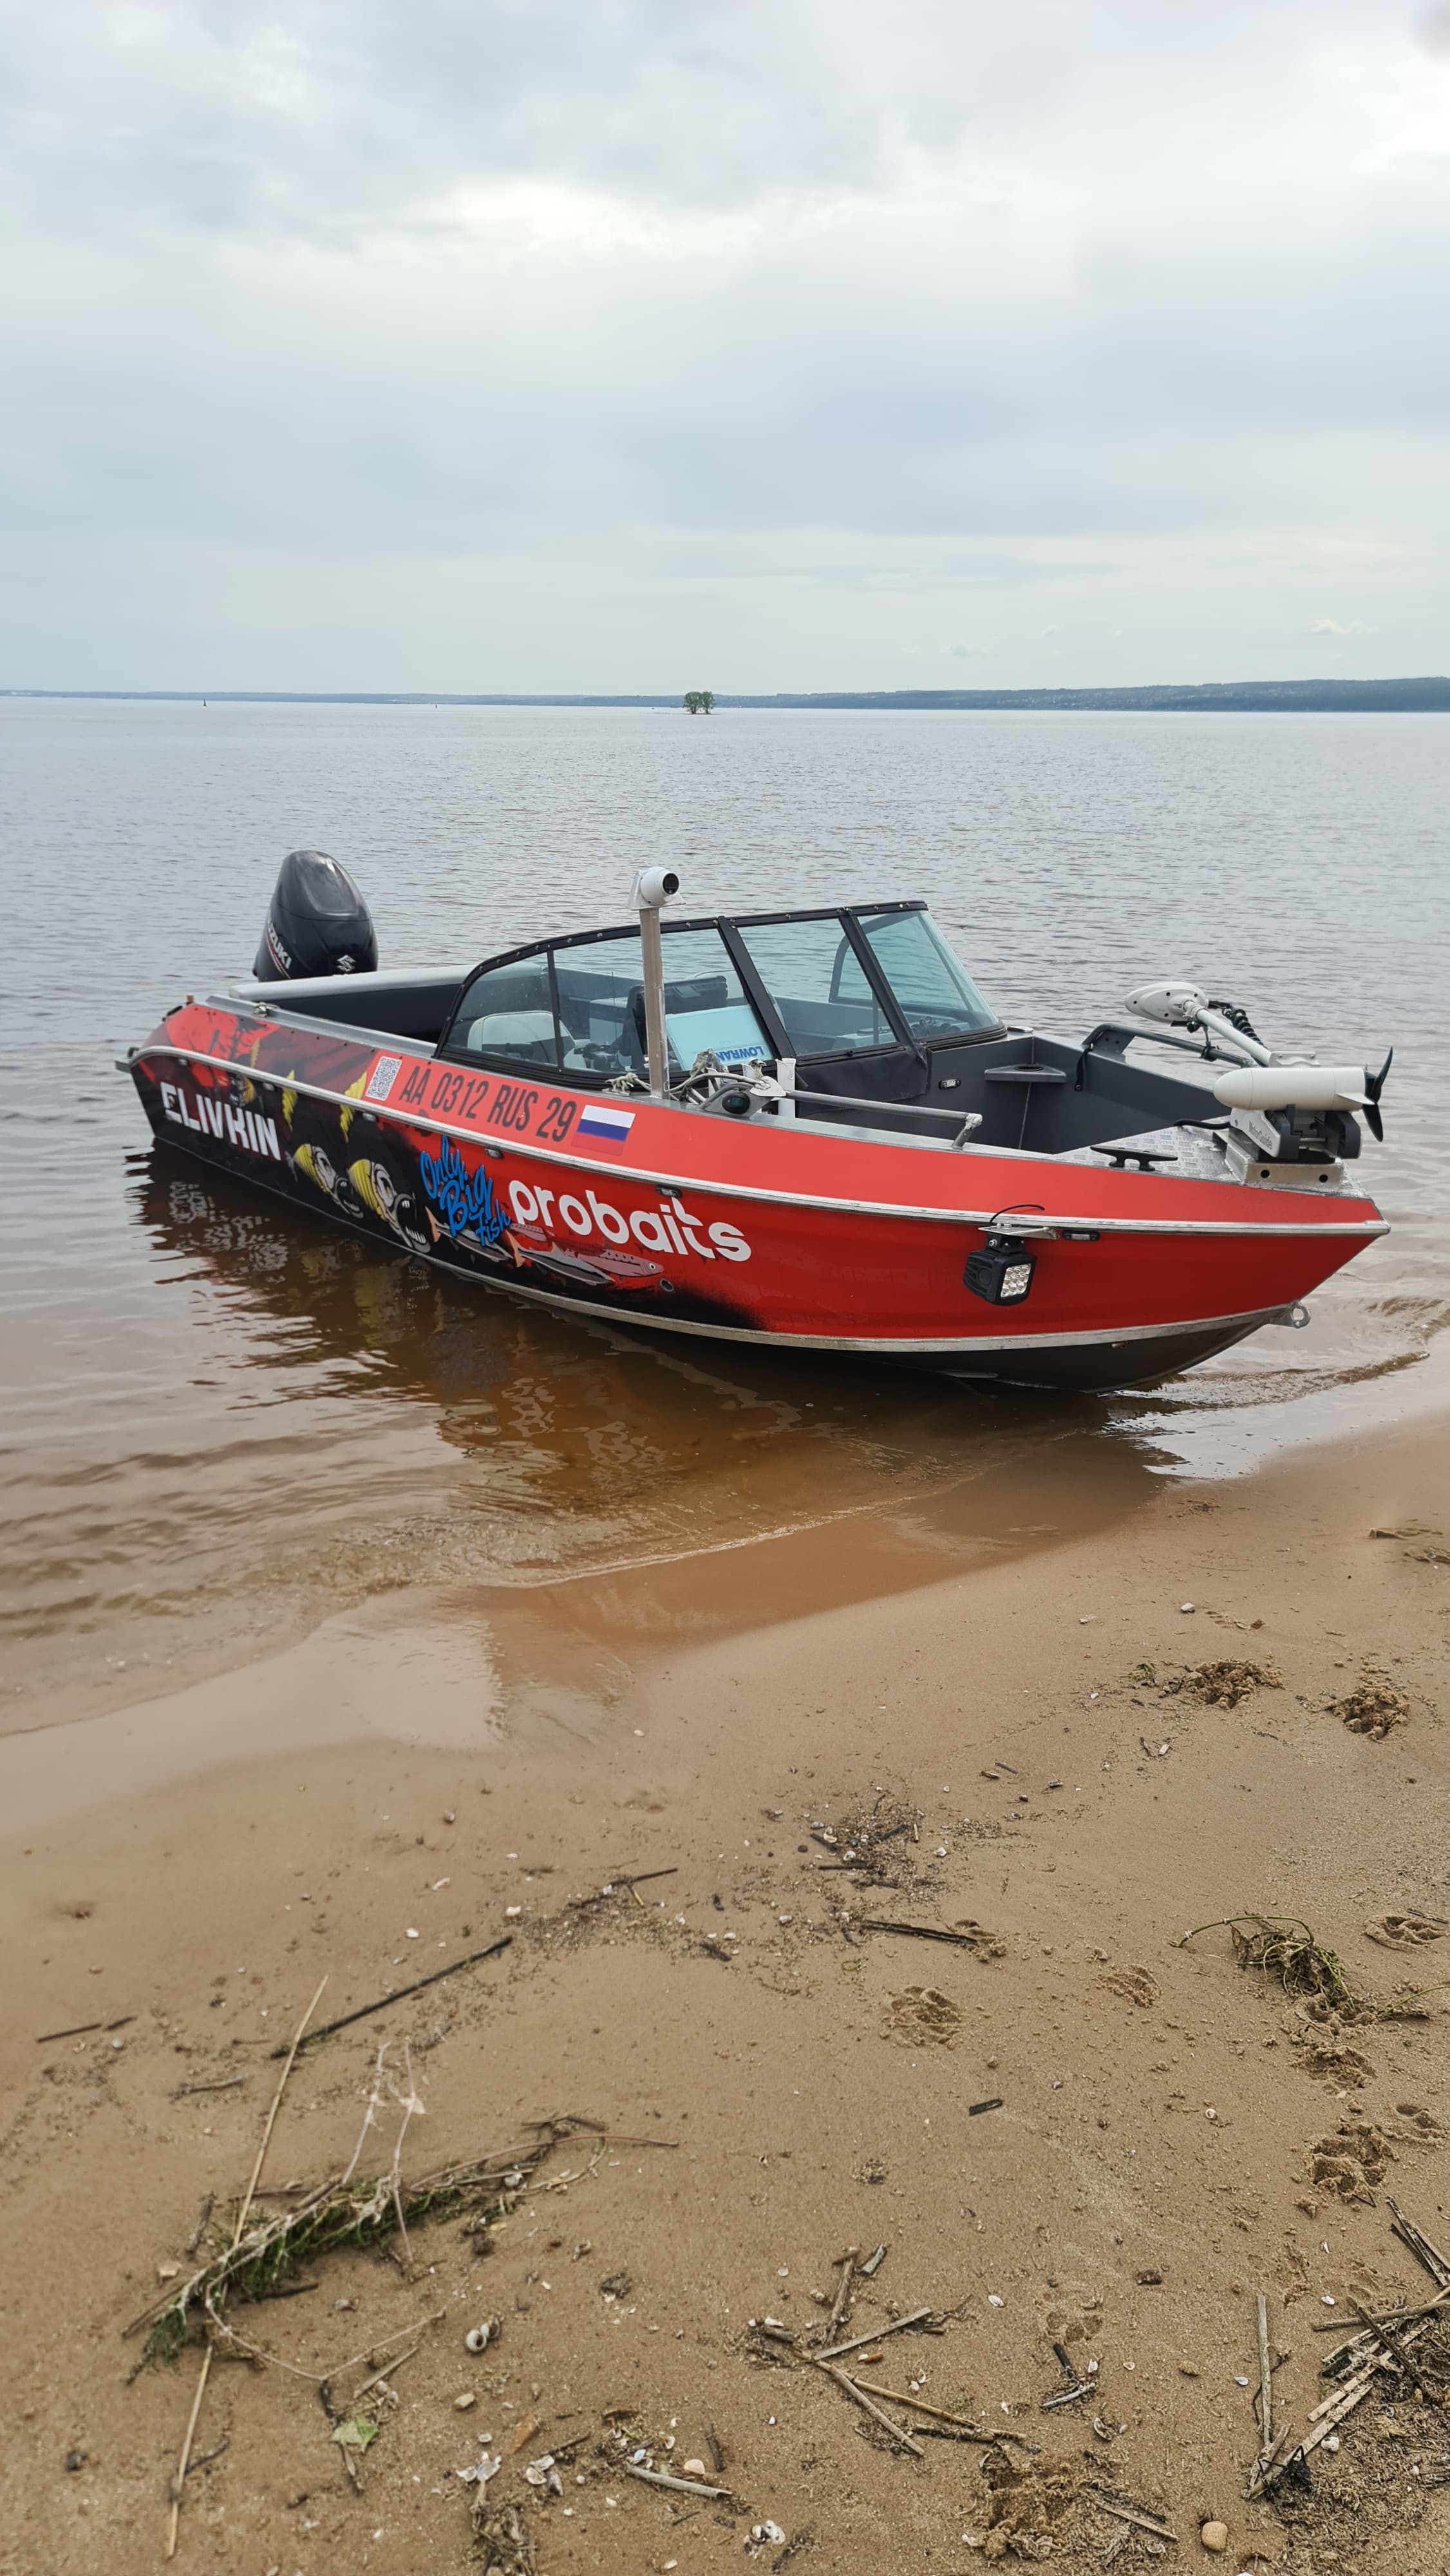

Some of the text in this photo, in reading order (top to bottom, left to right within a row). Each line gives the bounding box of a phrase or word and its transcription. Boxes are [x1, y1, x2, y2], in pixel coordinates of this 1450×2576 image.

[716, 1046, 764, 1061] LOWRAN
[399, 1066, 577, 1142] AA 0312 RUS 29
[509, 1180, 752, 1262] probaits
